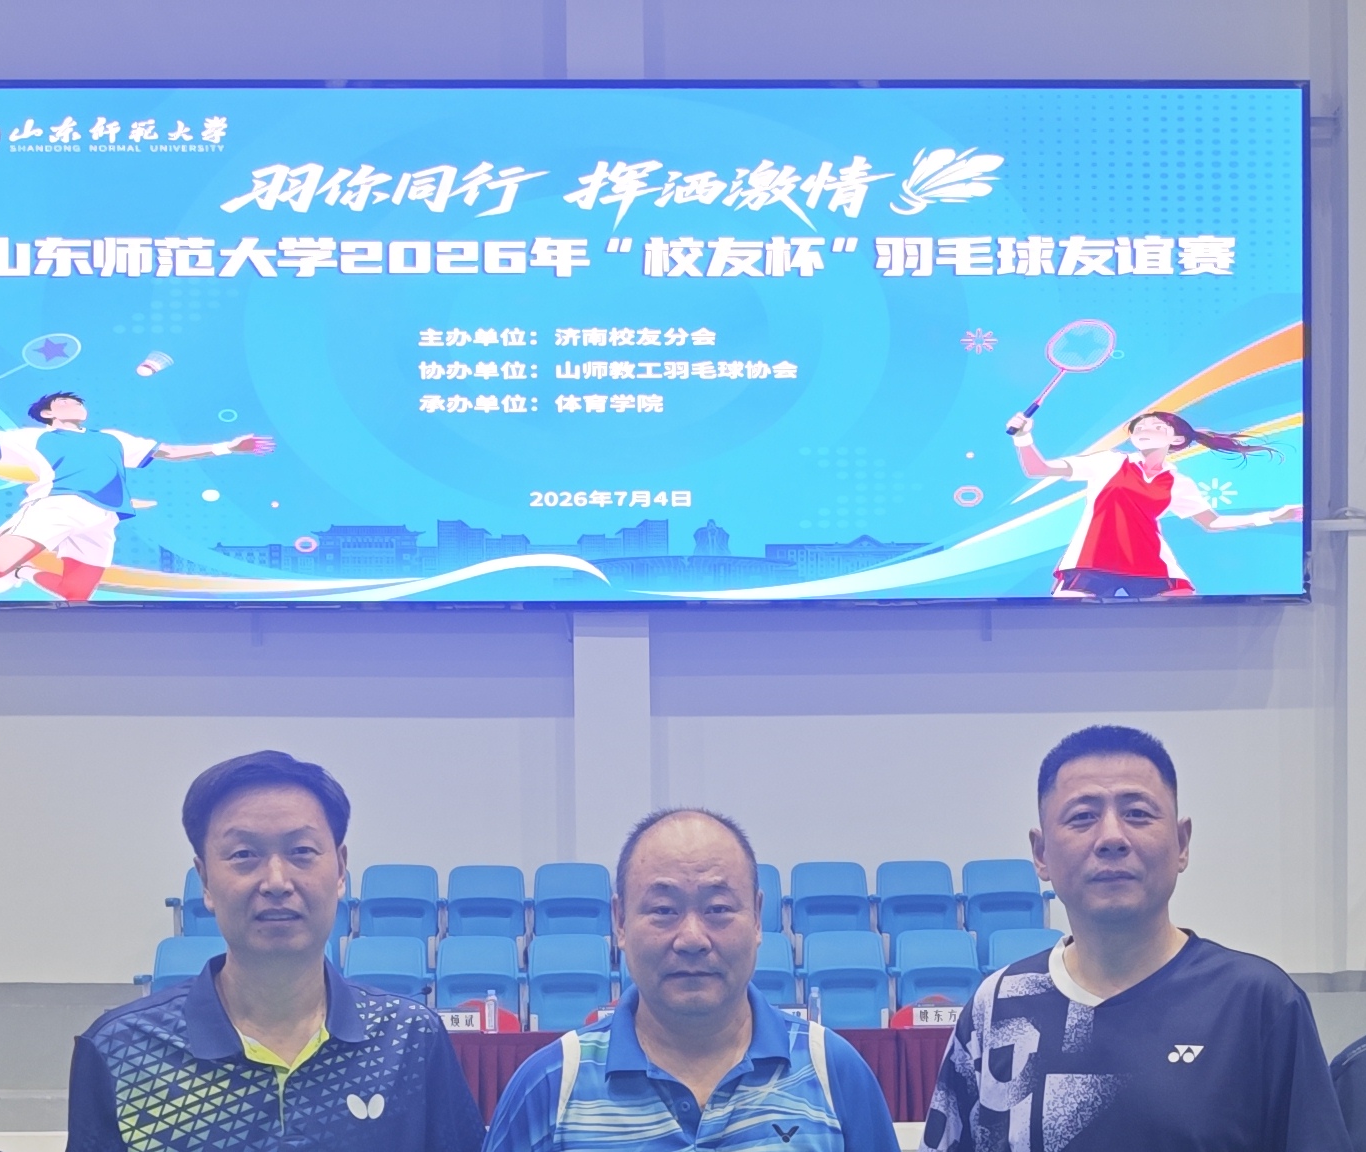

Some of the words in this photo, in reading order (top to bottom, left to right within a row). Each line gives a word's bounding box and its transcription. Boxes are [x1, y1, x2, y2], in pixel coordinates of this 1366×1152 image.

[10, 144, 81, 153] SHANDONG
[89, 144, 141, 153] NORMAL
[150, 144, 225, 153] UNIVERSITY
[221, 161, 549, 217] 羽你同行
[564, 156, 895, 231] 挥洒激情
[529, 489, 692, 508] 2026年7月4日
